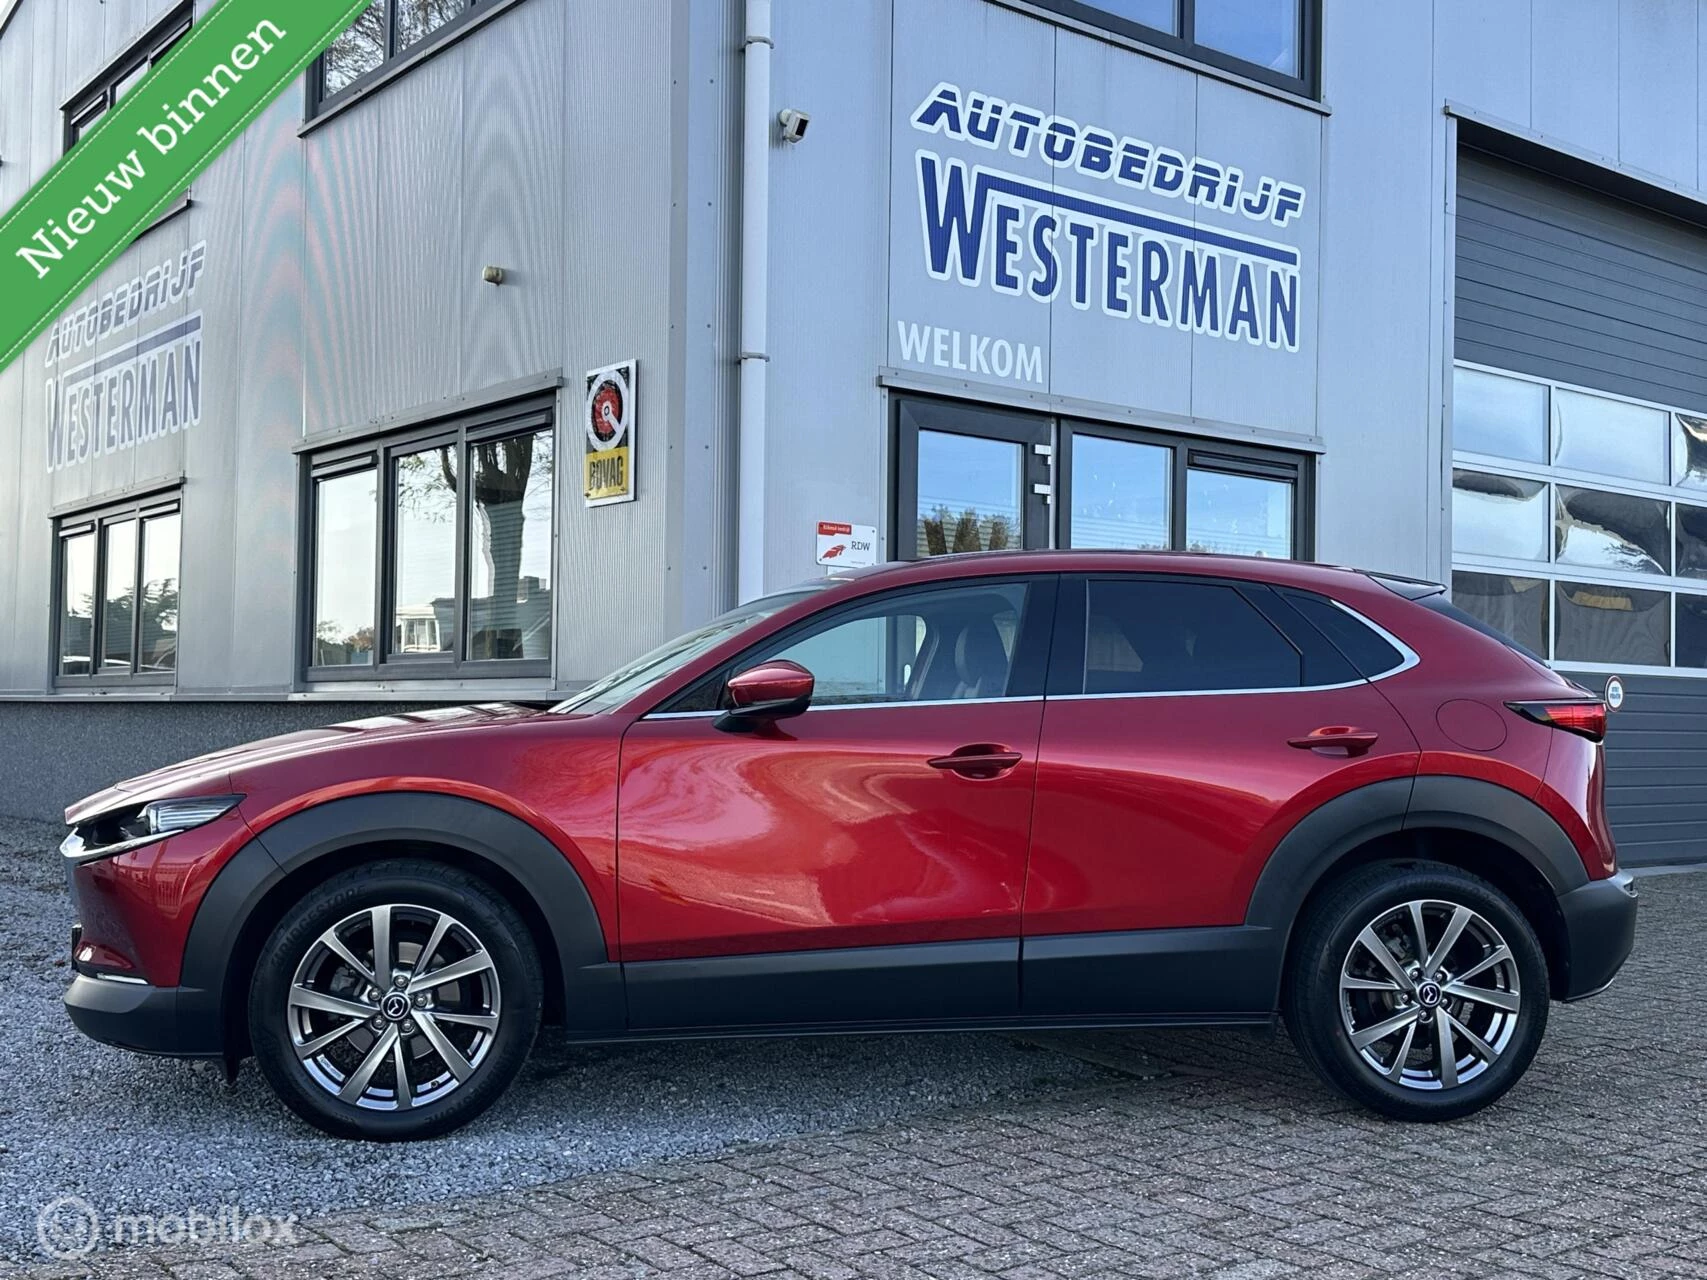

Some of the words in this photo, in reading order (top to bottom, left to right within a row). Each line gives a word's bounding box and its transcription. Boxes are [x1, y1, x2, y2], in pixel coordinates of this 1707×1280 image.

[910, 82, 1305, 228] AUTOBEDRIJF
[45, 240, 206, 368] AUTOBEDRIJF
[915, 150, 1300, 353] WESTERMAN
[45, 333, 202, 474] WESTERMAN
[897, 320, 1043, 384] WELKOM
[588, 455, 624, 491] BOVAG
[851, 540, 870, 551] RDW
